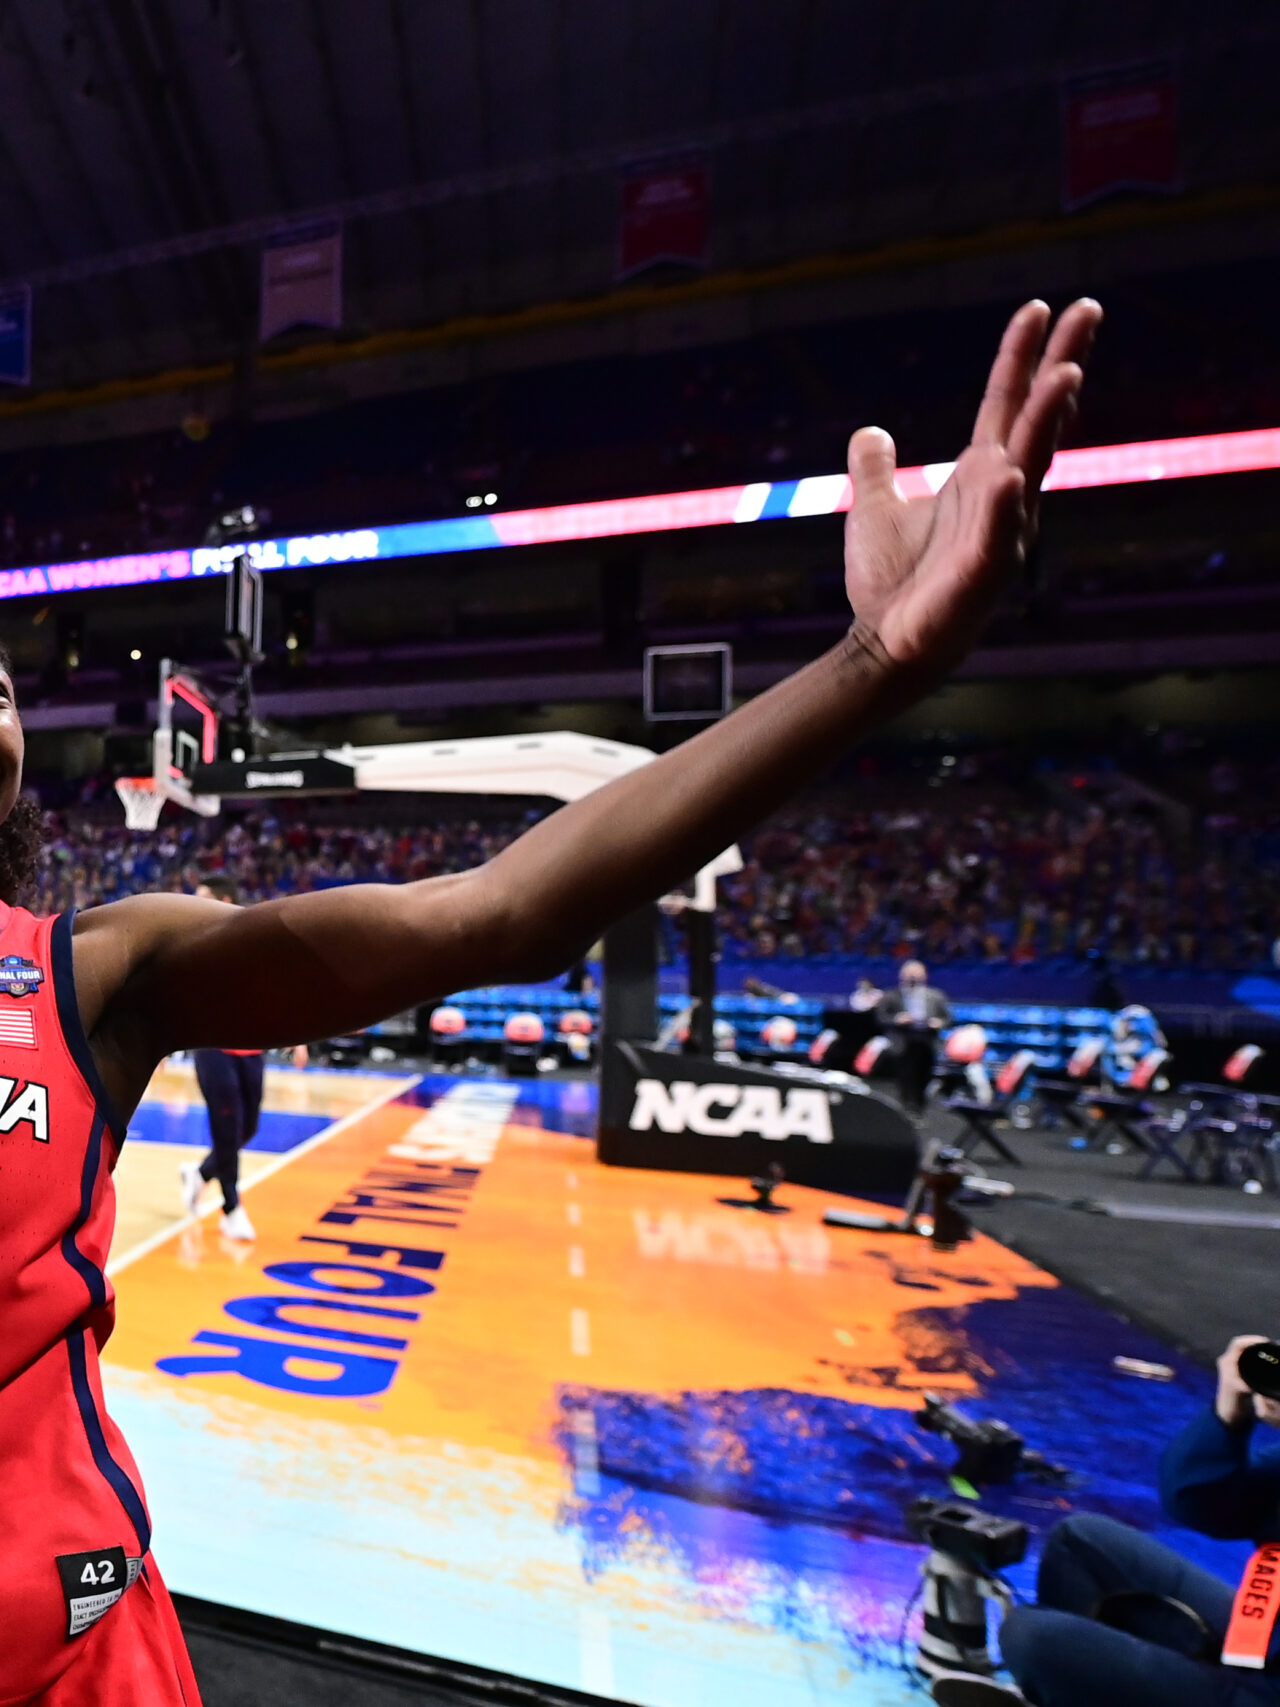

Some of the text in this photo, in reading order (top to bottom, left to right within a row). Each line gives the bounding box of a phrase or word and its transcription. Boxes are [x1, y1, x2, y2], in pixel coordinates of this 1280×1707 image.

[47, 550, 191, 592] WOMEN'S
[287, 529, 379, 567] FOUR
[16, 970, 40, 980] FOUR
[628, 1077, 834, 1144] NCAA
[154, 1234, 448, 1399] FOUR
[80, 1559, 116, 1586] 42
